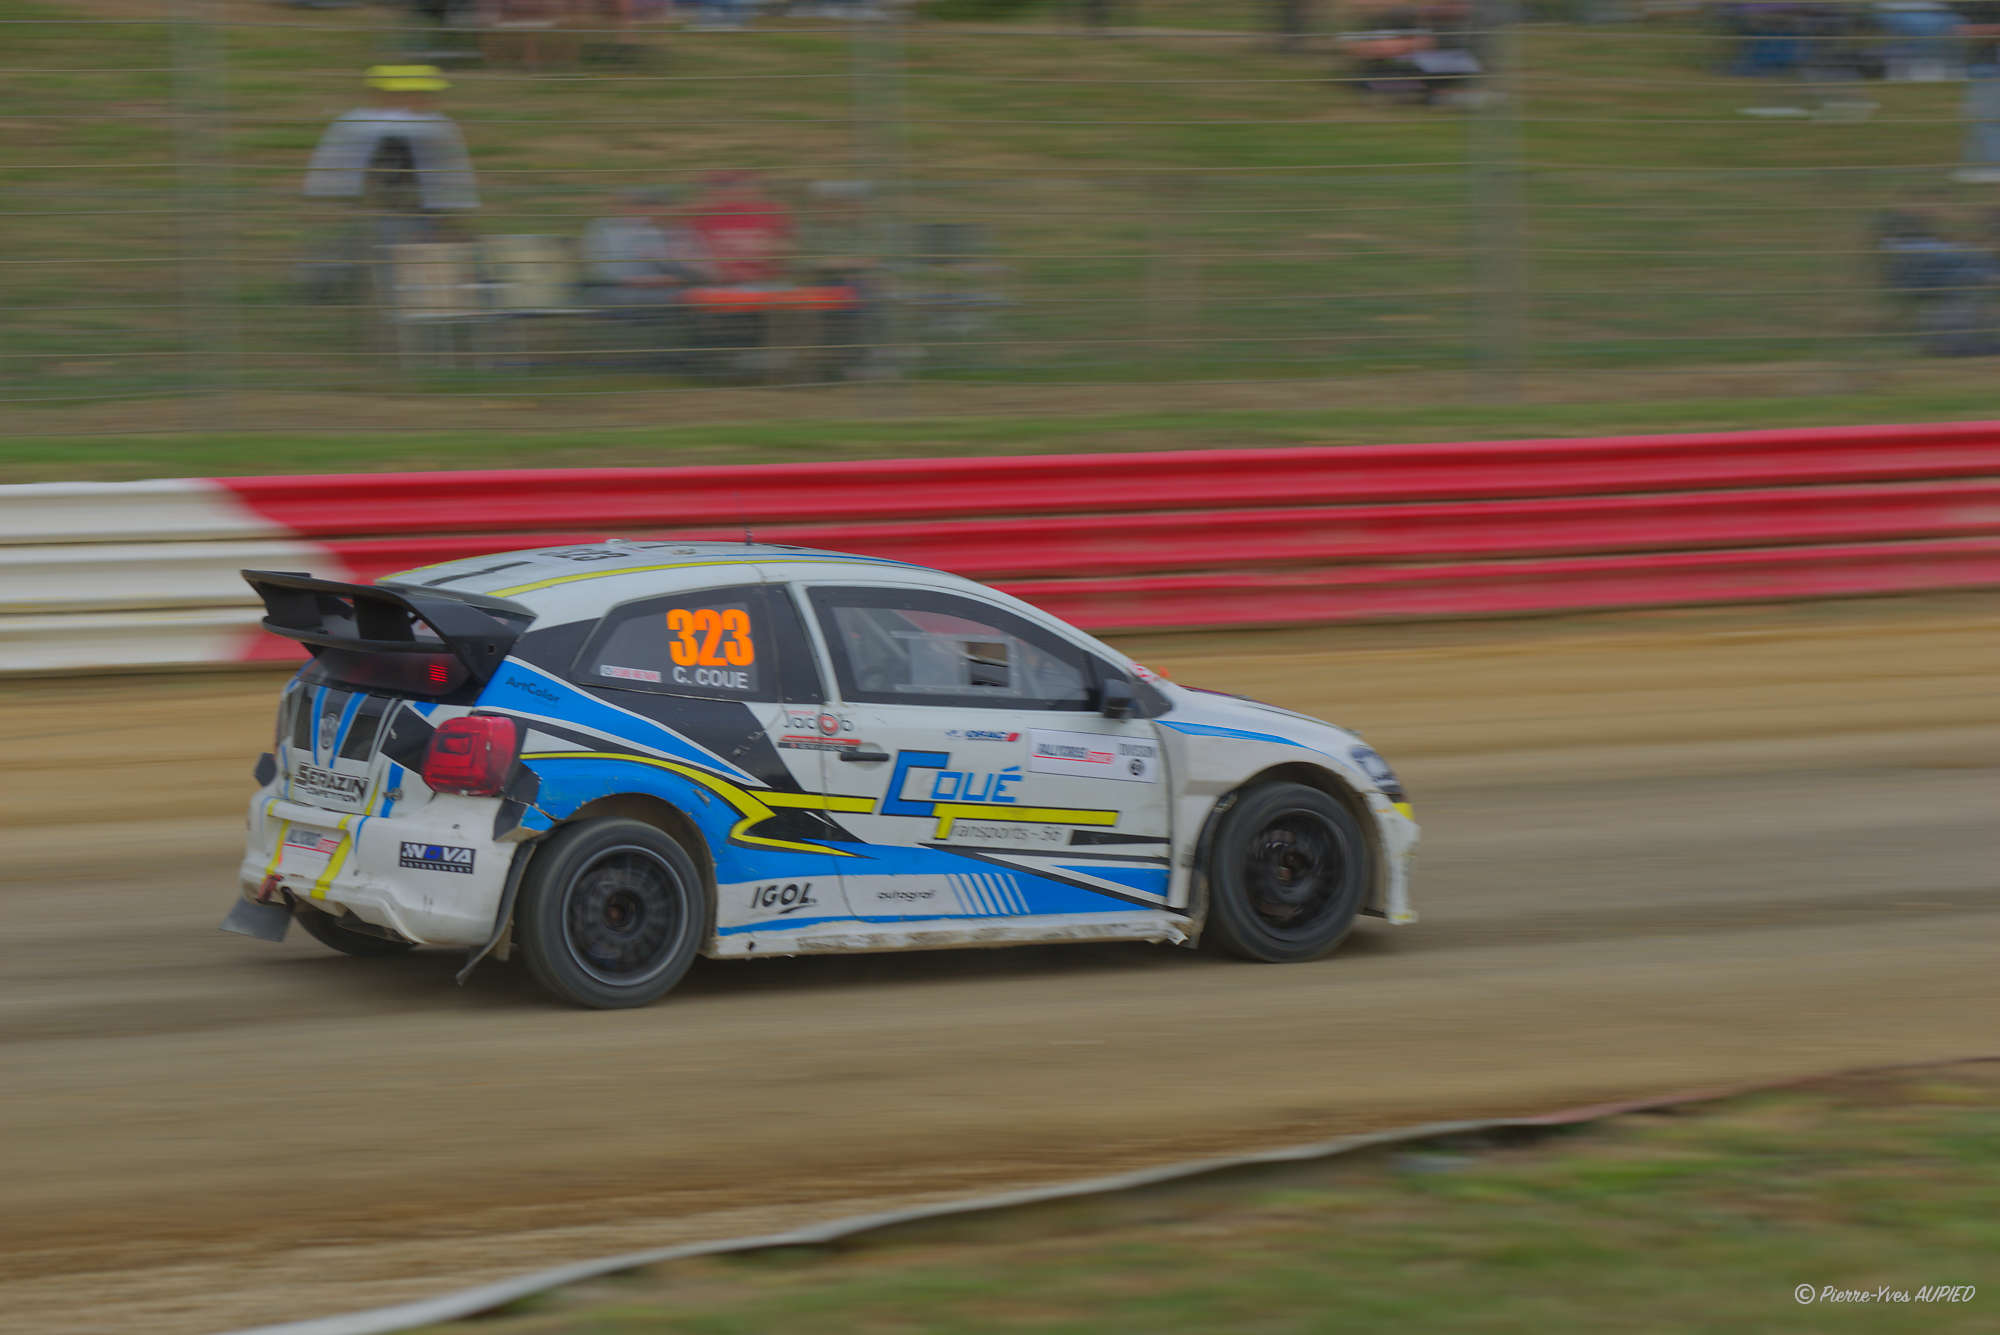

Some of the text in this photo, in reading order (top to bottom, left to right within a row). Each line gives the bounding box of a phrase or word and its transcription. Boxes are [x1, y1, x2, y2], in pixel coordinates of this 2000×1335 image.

[667, 608, 755, 667] 323
[672, 666, 693, 684] C.
[696, 668, 750, 690] COUE
[295, 761, 370, 799] SERAZIN
[752, 882, 816, 909] IGOL
